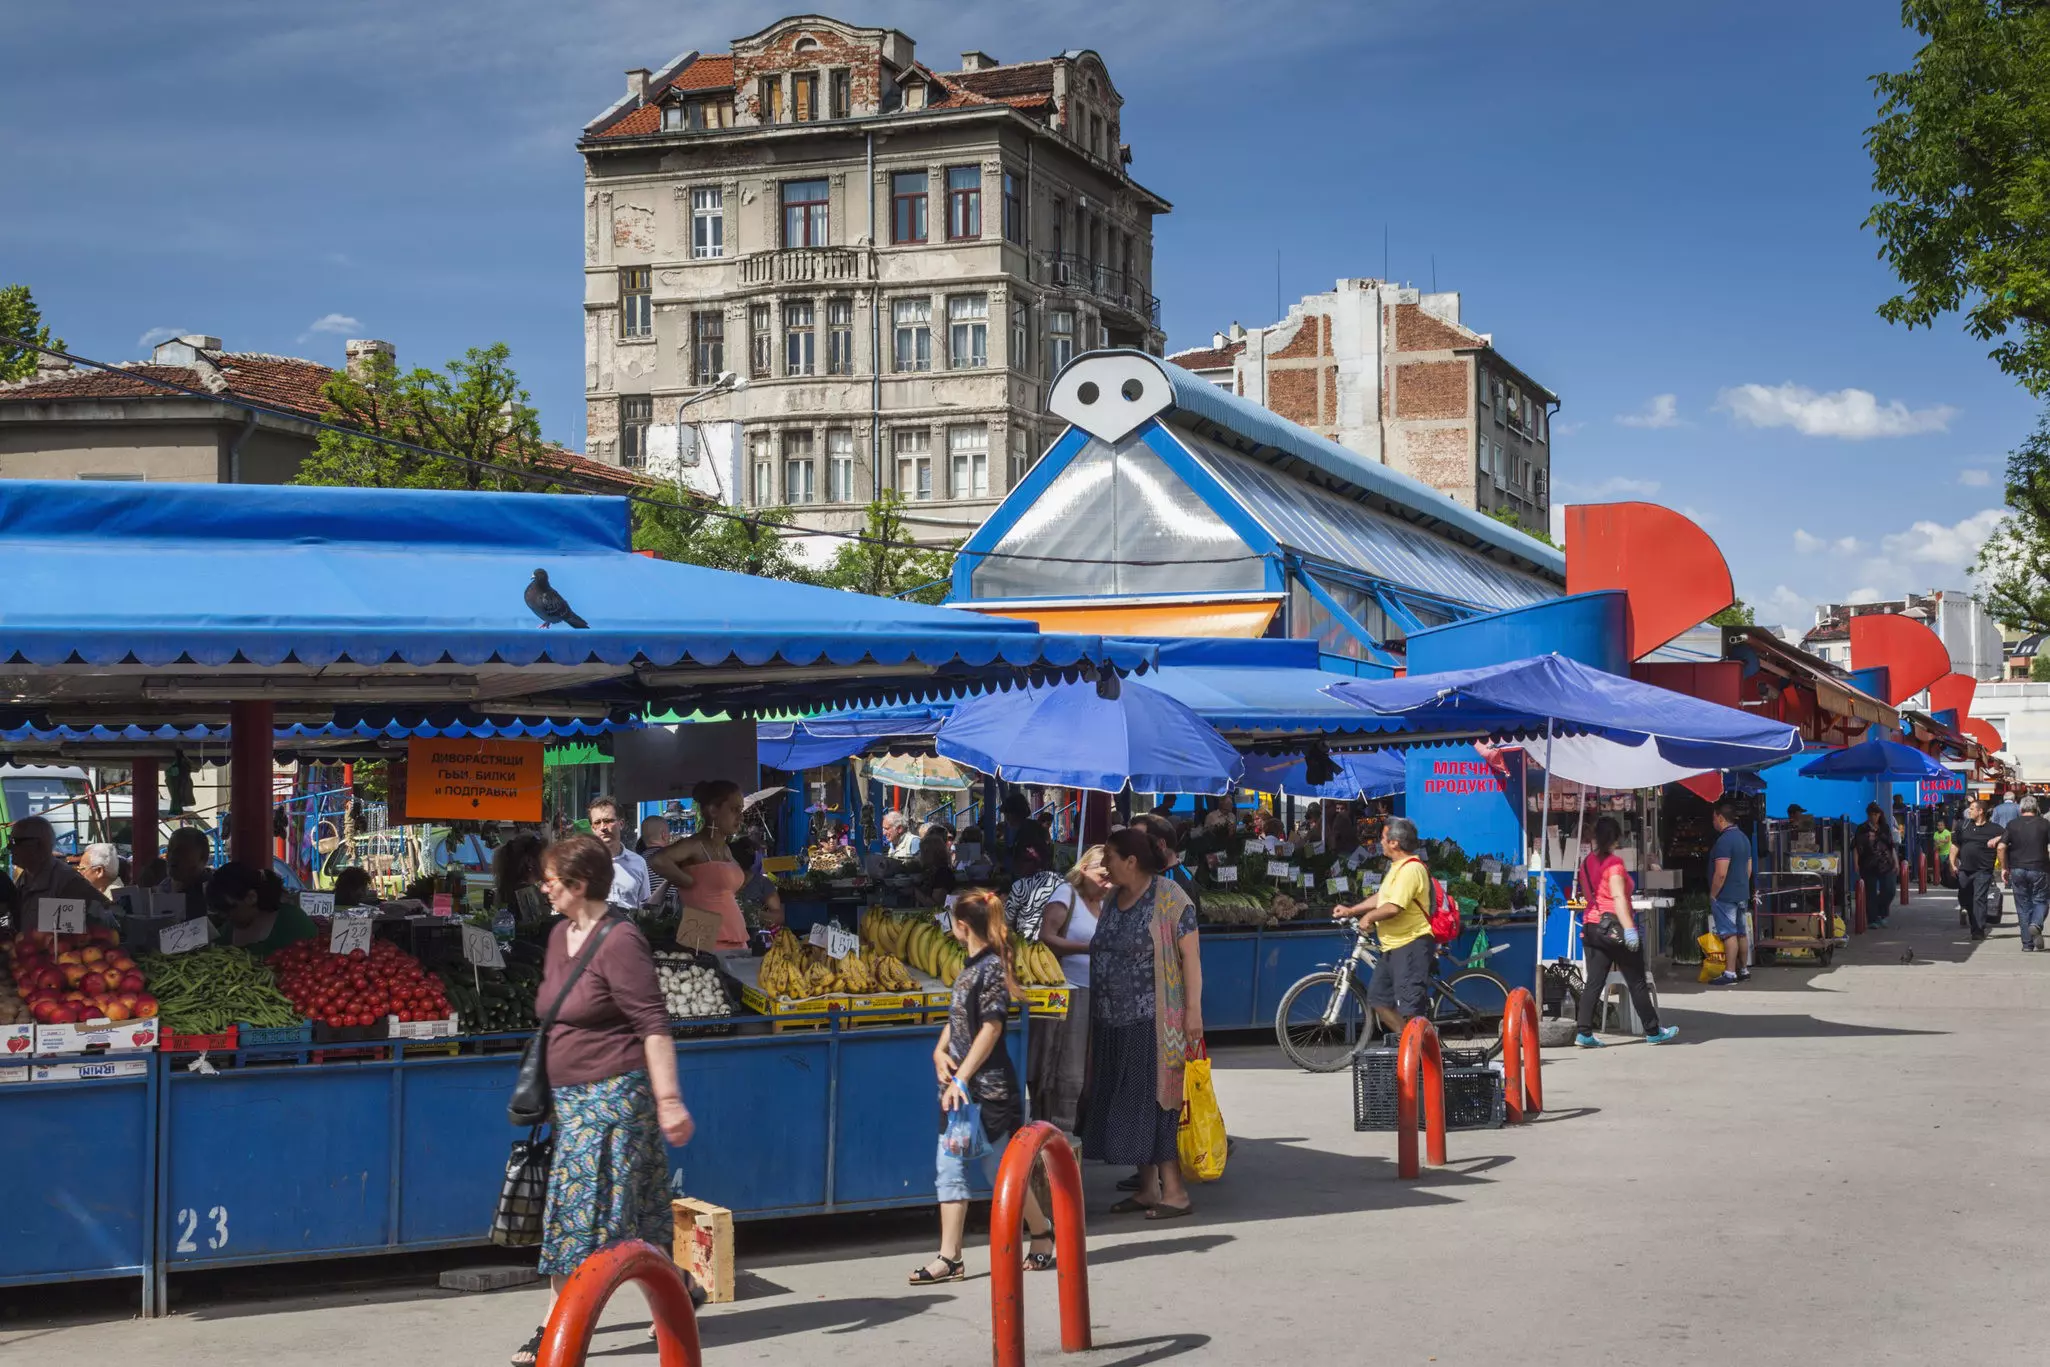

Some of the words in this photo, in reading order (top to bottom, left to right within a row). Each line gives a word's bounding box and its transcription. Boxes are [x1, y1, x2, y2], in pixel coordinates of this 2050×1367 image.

[475, 771, 516, 782] БИЛКИ
[445, 785, 518, 798] ПОДПРАВКИ
[176, 1206, 228, 1252] 23
